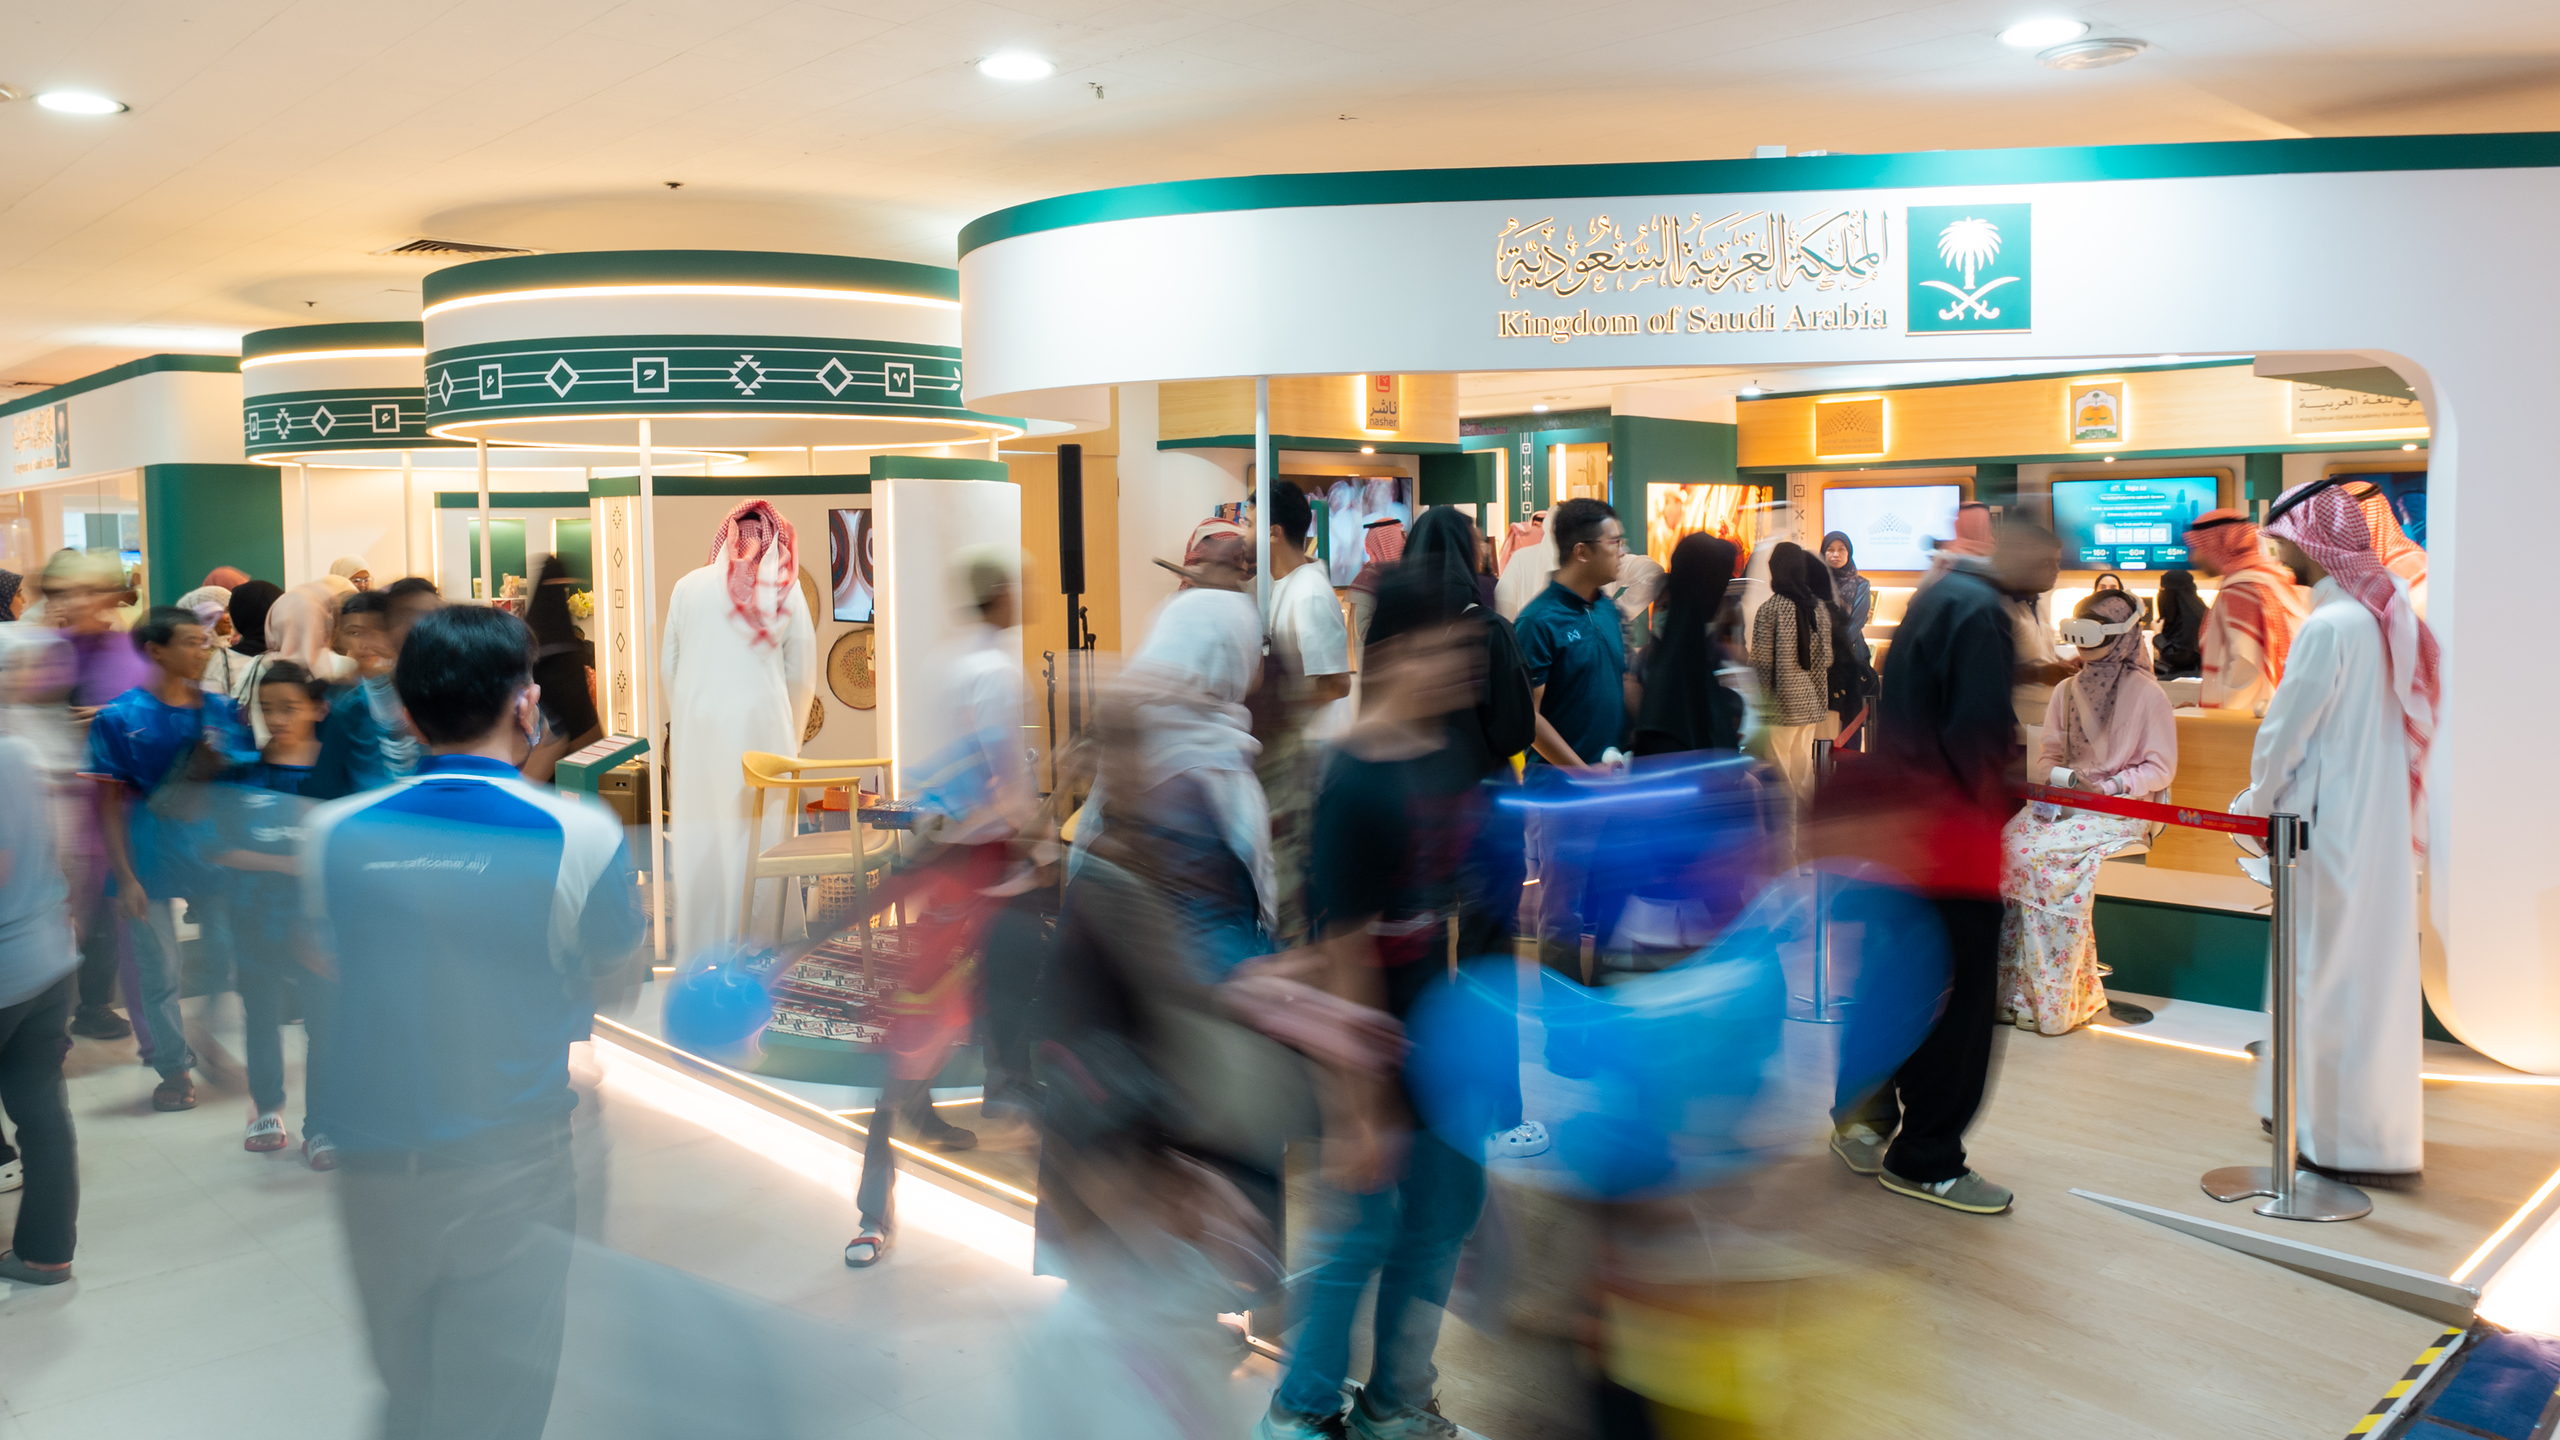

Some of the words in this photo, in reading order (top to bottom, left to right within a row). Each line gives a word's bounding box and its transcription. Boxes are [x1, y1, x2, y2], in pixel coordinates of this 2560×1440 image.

[1498, 308, 1641, 344] Kingdom
[1647, 304, 1683, 335] of
[1686, 303, 1777, 334] Saudi
[1782, 301, 1889, 332] Arabia
[1370, 399, 1397, 416] ناشر
[1369, 417, 1397, 427] nasher
